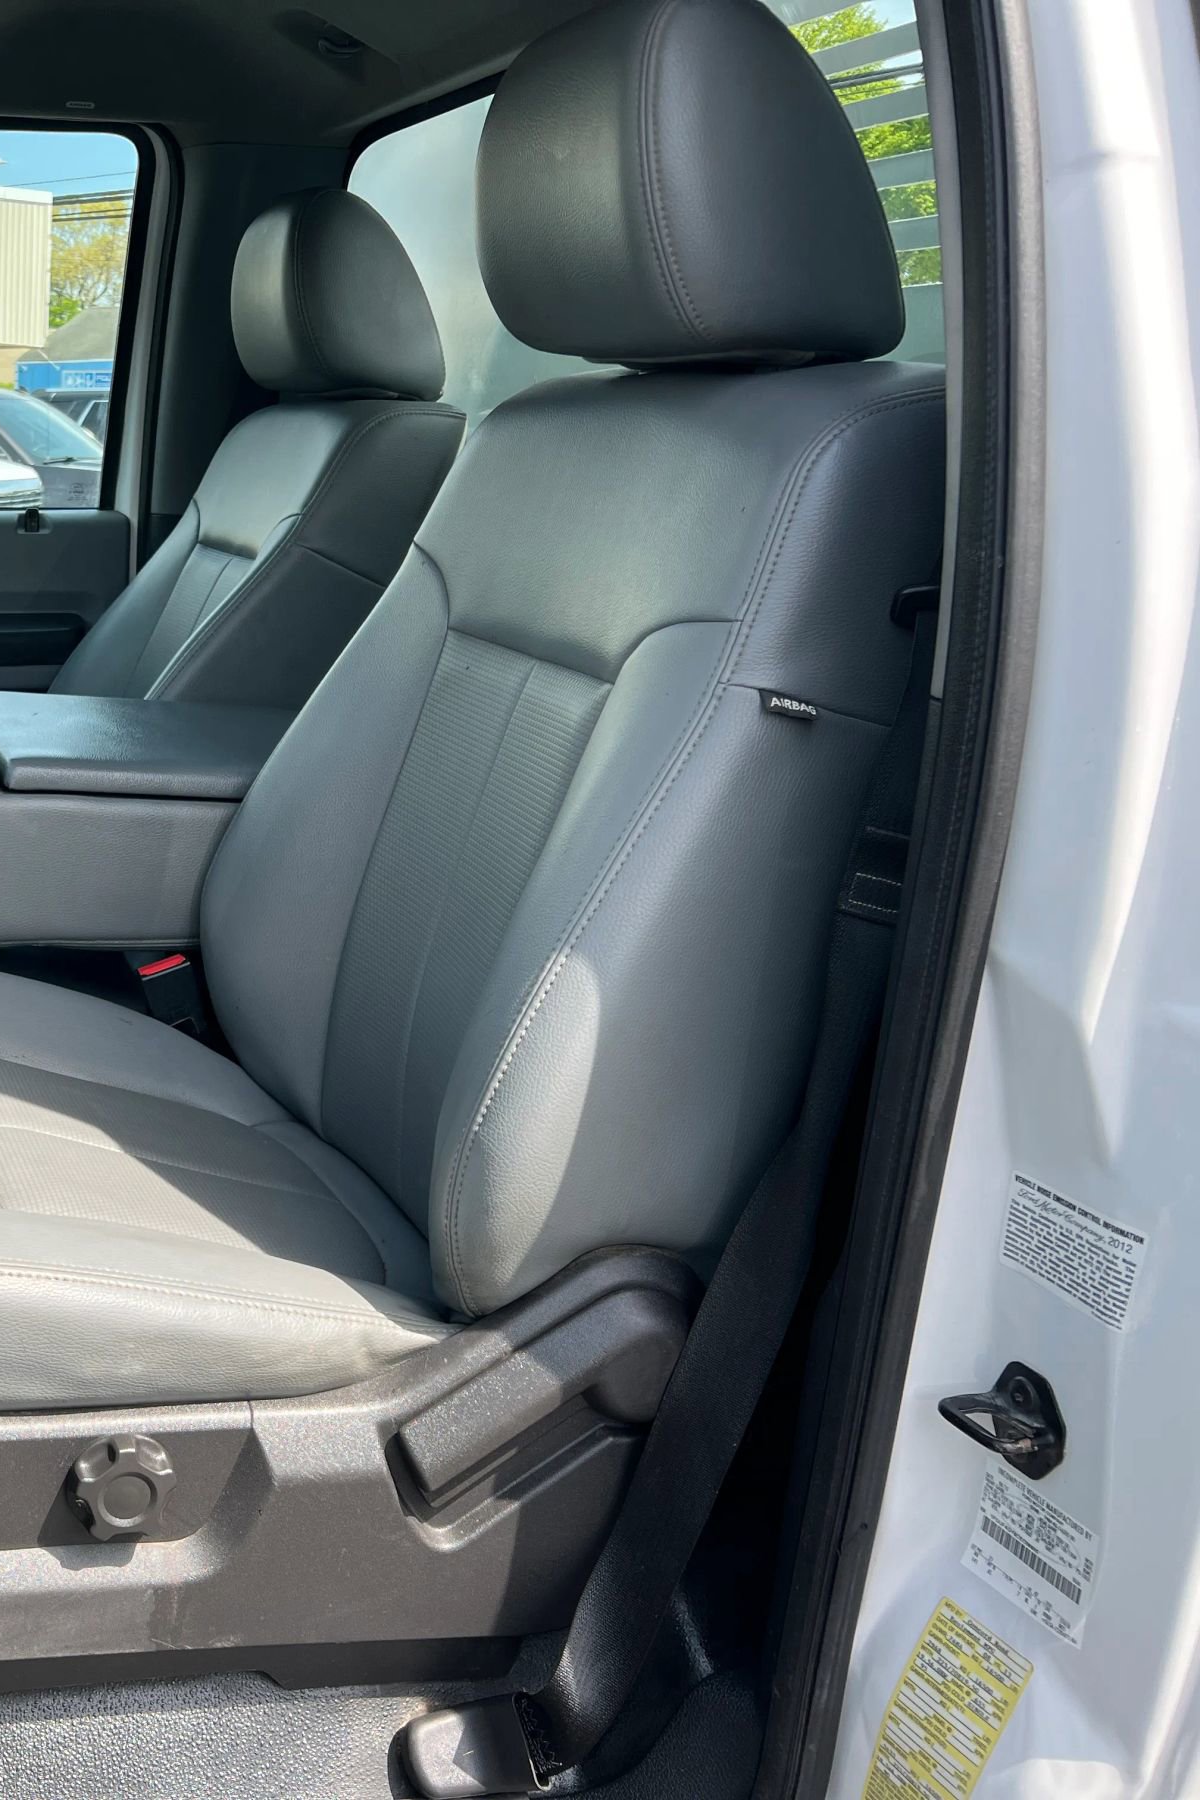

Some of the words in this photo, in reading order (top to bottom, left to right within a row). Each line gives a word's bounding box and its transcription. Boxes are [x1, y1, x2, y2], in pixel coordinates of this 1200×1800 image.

[770, 697, 817, 715] AIRBAG
[1015, 1175, 1036, 1191] VEHICLE
[1053, 1195, 1076, 1211] EMISSION
[1078, 1208, 1102, 1224] CONTROL
[1103, 1221, 1144, 1246] INFORMATION
[1108, 1236, 1133, 1254] 2012
[1026, 1488, 1045, 1506] VEHICLE
[1085, 1531, 1092, 1541] BY
